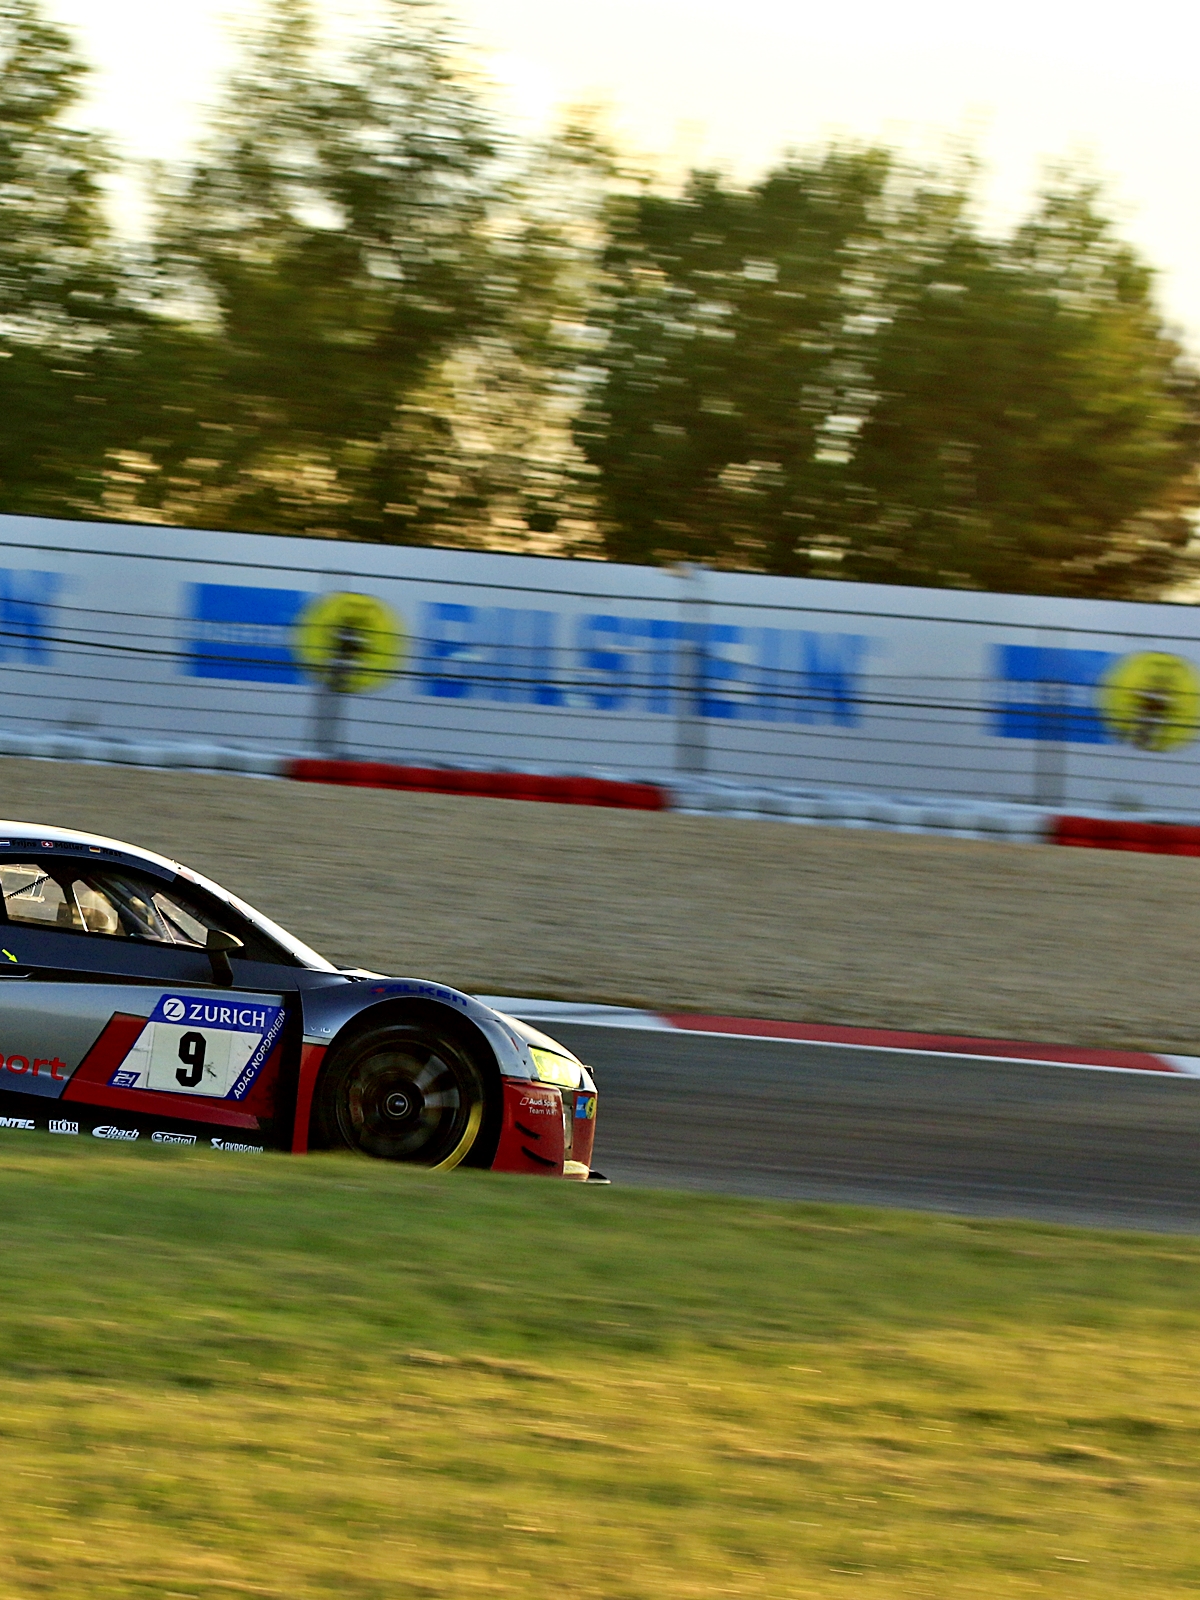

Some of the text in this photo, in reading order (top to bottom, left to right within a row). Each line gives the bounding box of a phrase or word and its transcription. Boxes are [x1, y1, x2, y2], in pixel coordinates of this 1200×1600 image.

[188, 1003, 266, 1028] ZURICH
[175, 1031, 207, 1088] 9
[233, 1009, 286, 1100] ADAC NORDRHEIN
[50, 1118, 78, 1132] HÖR
[92, 1126, 140, 1139] Eibach
[163, 1134, 193, 1146] Castrol
